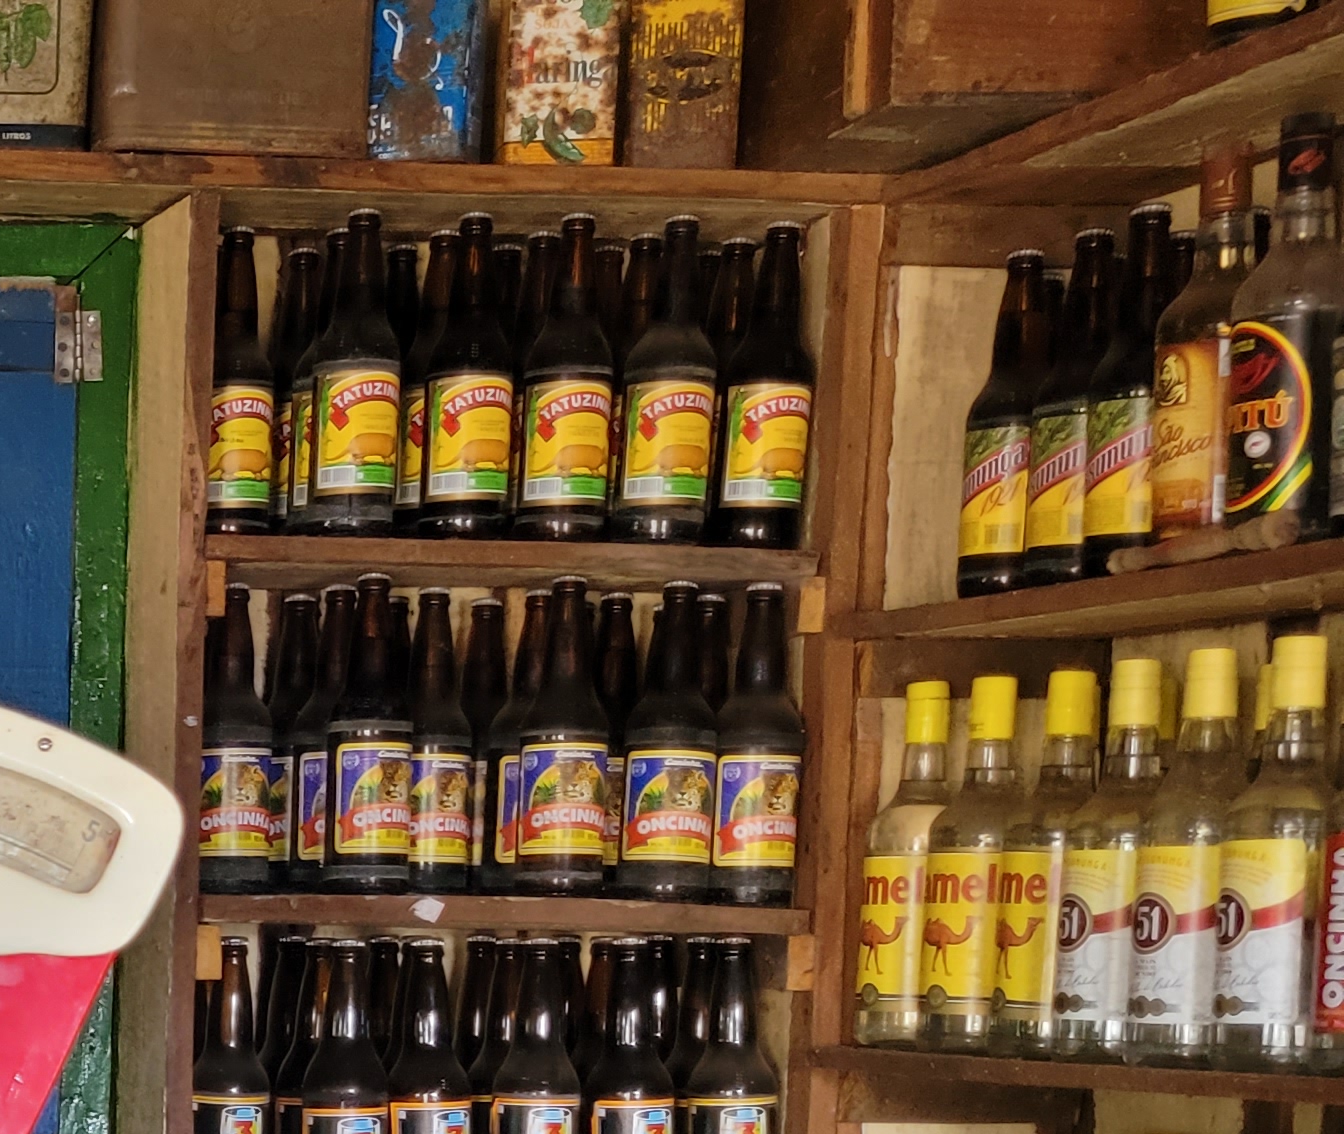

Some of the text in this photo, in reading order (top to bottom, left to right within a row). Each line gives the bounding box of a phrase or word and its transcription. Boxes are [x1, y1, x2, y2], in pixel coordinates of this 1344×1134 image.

[1, 132, 32, 141] LITROS
[1229, 389, 1294, 434] ITÚ
[1061, 905, 1080, 940] 51
[1136, 902, 1162, 941] 51
[1220, 901, 1237, 938] 51
